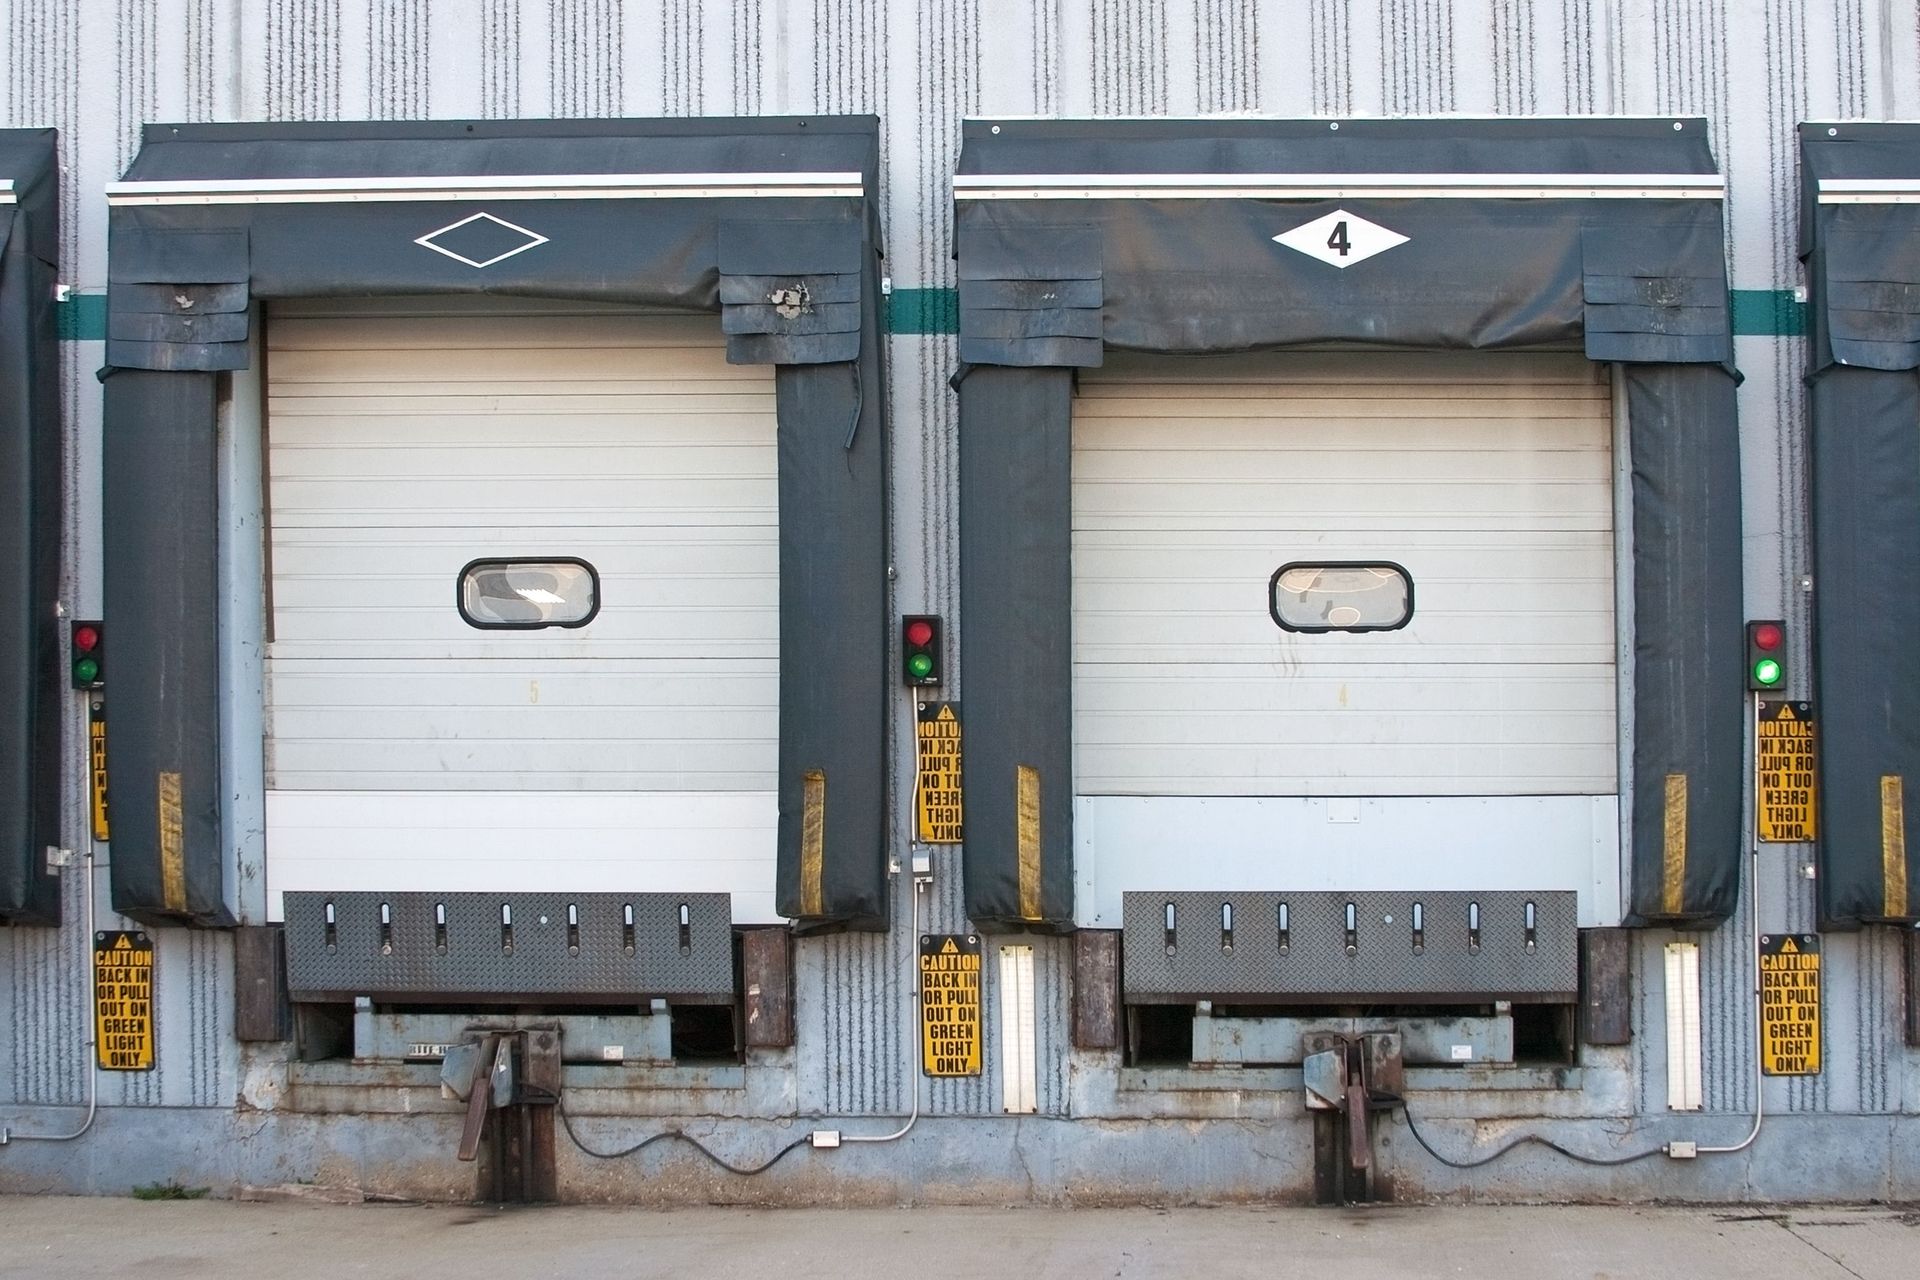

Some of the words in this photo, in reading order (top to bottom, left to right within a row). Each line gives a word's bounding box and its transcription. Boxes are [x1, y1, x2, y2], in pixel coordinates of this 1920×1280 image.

[1327, 221, 1351, 256] 4
[95, 950, 152, 966] CAUTION
[920, 954, 980, 971] CAUTION
[1760, 953, 1820, 970] CAUTION
[98, 968, 132, 983] BACK
[136, 968, 149, 983] IN
[924, 972, 960, 988] BACK
[963, 972, 977, 988] IN
[1764, 971, 1799, 988] BACK
[1803, 971, 1816, 988] IN
[98, 985, 115, 1000] OR
[120, 985, 149, 1000] PULL
[924, 989, 943, 1005] OR
[947, 989, 978, 1005] PULL
[1764, 988, 1782, 1005] OR
[1787, 988, 1818, 1005] PULL
[100, 1001, 126, 1017] OUT
[130, 1001, 147, 1017] ON
[926, 1006, 953, 1022] OUT
[958, 1006, 976, 1022] ON
[1766, 1005, 1793, 1022] OUT
[1797, 1005, 1815, 1022] ON
[104, 1018, 145, 1034] GREEN
[930, 1023, 973, 1039] GREEN
[1769, 1022, 1813, 1039] GREEN
[106, 1035, 145, 1050] LIGHT
[931, 1040, 973, 1057] LIGHT
[1771, 1039, 1813, 1056] LIGHT
[110, 1051, 140, 1067] ONLY
[936, 1057, 969, 1073] ONLY
[1775, 1055, 1808, 1072] ONLY
